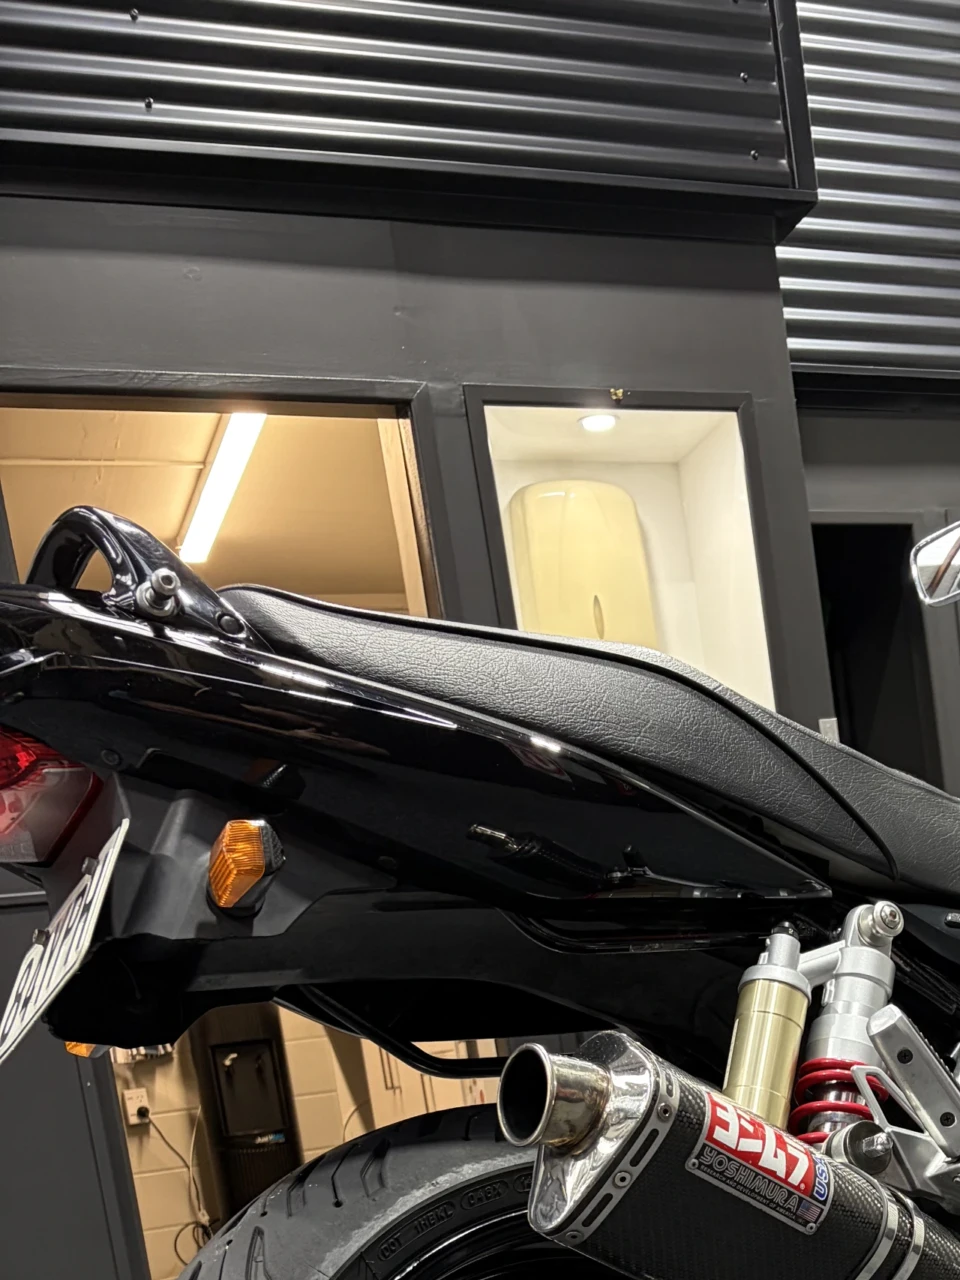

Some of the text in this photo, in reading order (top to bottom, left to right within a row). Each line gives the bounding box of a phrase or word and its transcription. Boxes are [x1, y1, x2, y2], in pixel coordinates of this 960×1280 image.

[699, 1165, 726, 1182] RESEARCH
[725, 1179, 737, 1188] AND
[736, 1184, 770, 1206] DEVELOPMENT
[700, 1146, 799, 1213] YOSHIMURA
[813, 1154, 829, 1201] USA
[381, 1233, 405, 1258] DOT
